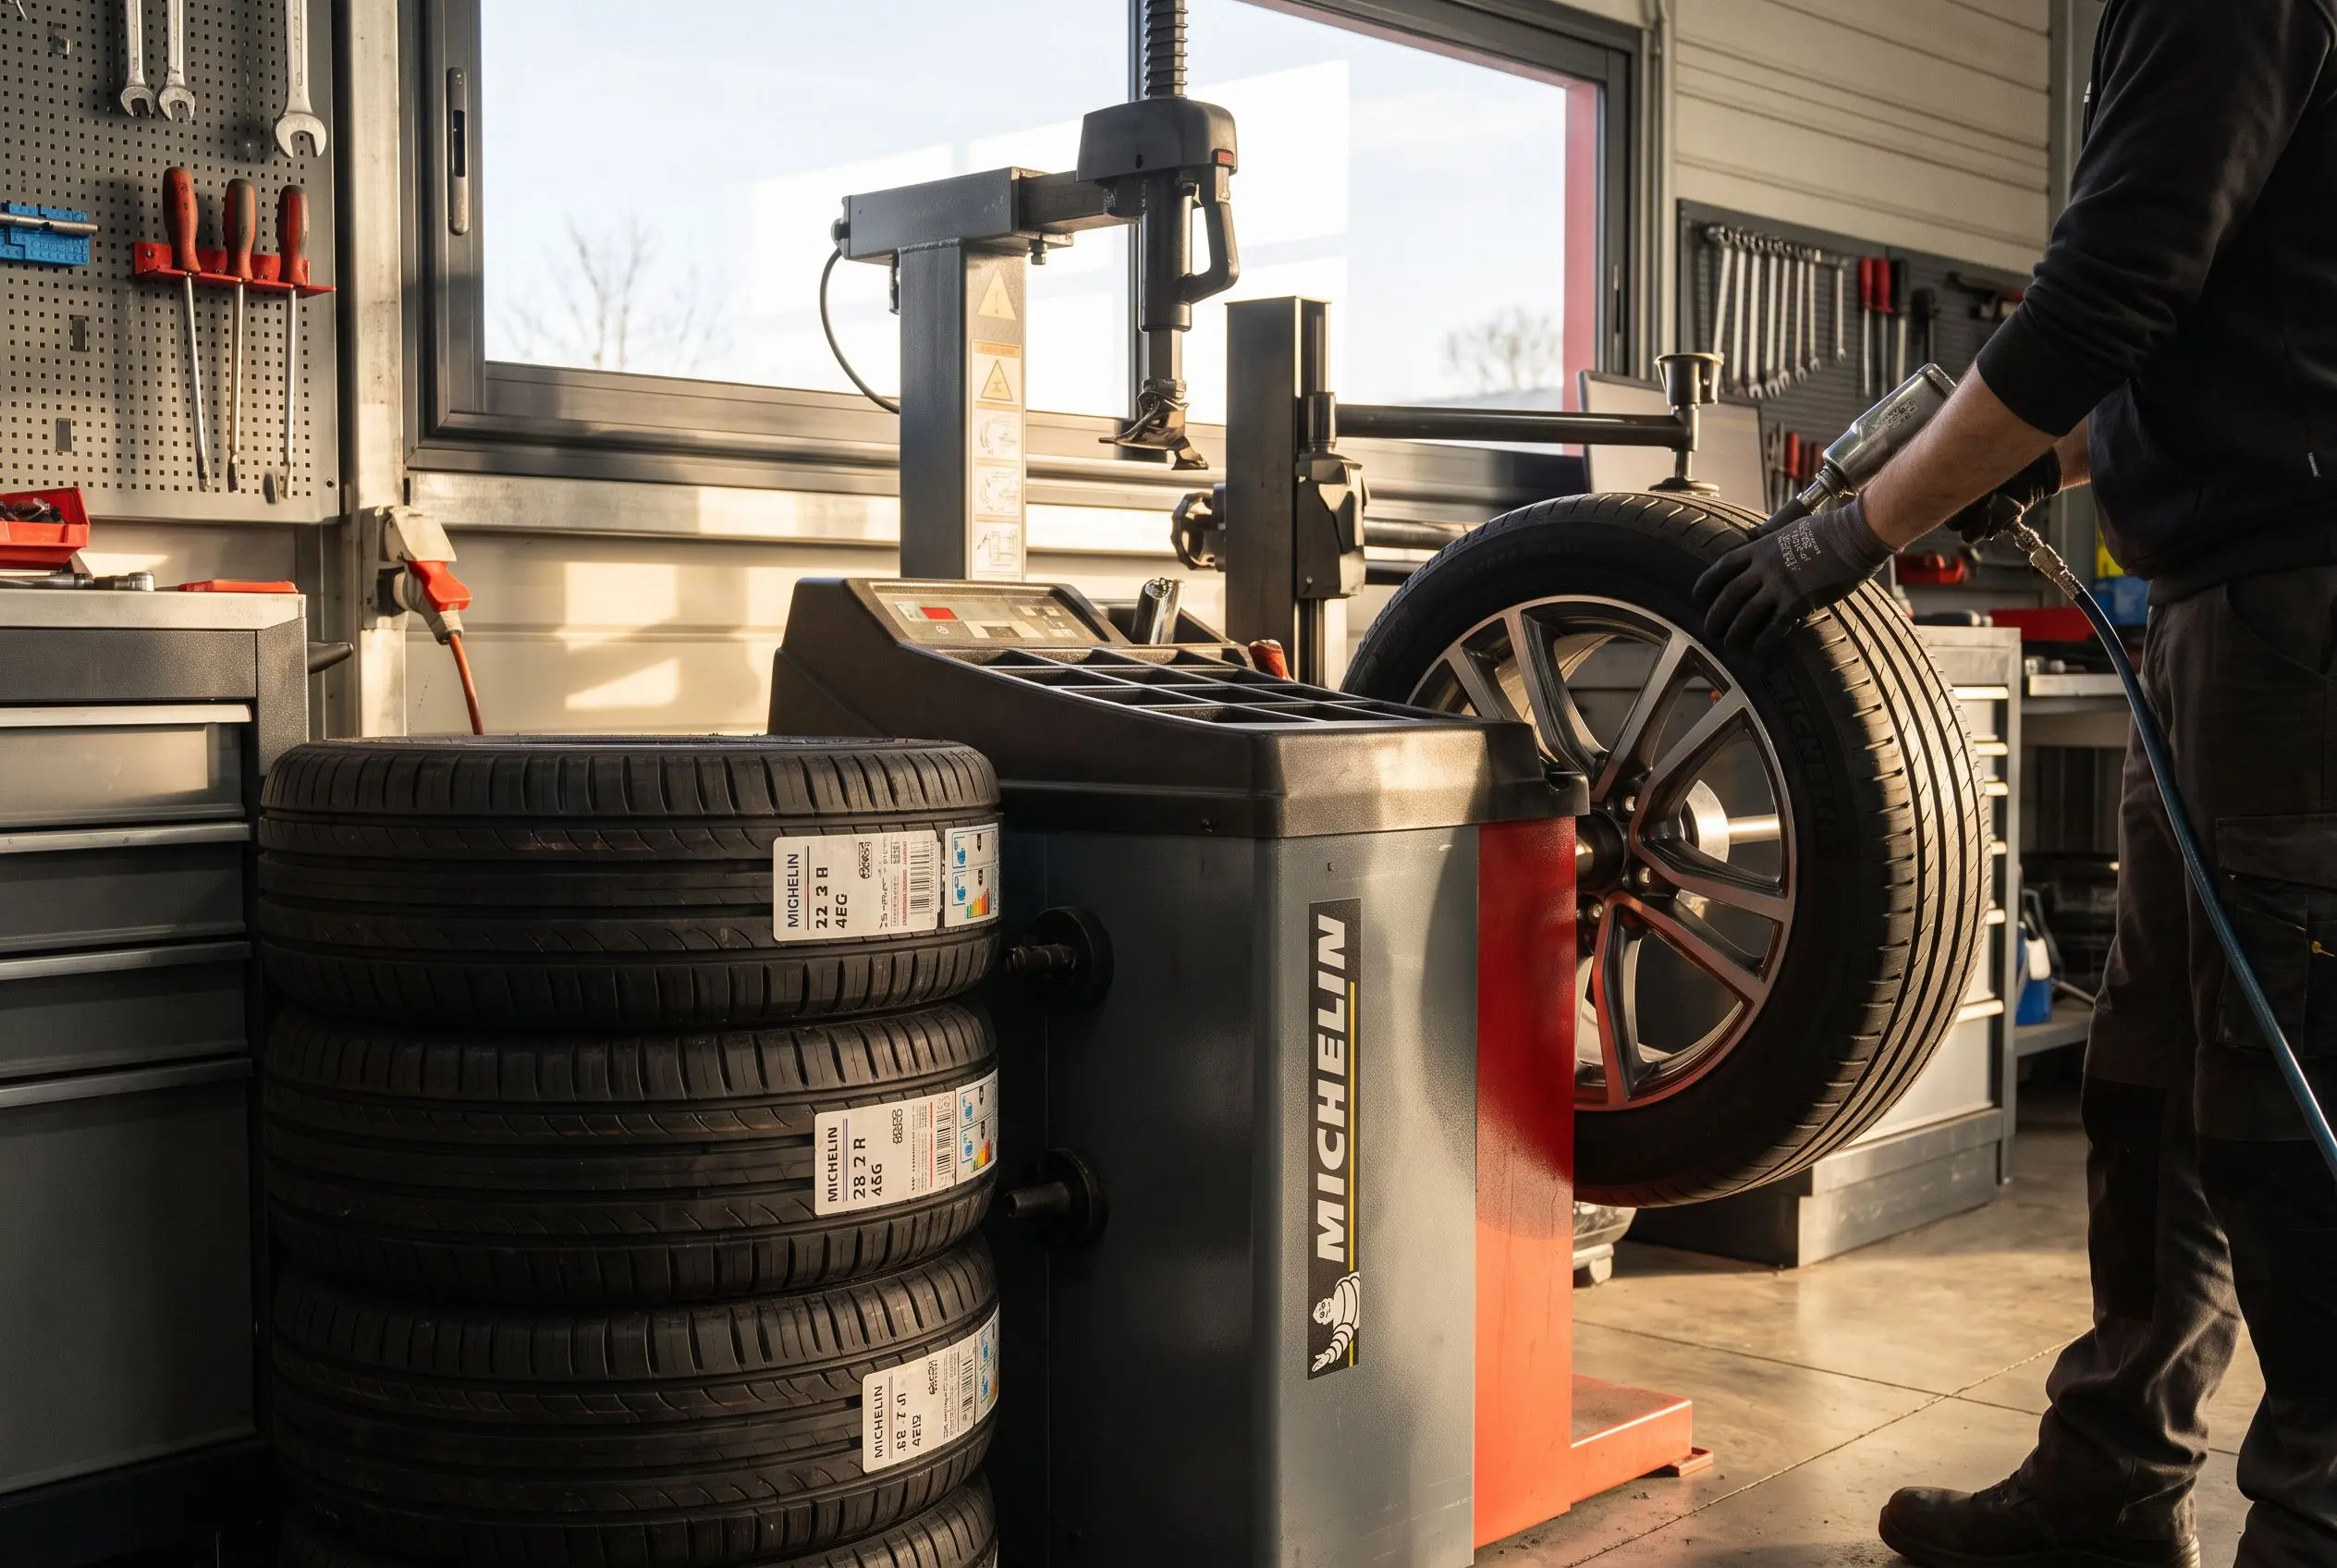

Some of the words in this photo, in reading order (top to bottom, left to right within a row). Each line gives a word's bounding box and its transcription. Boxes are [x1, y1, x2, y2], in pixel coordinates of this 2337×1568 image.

[815, 885, 828, 897] 3
[815, 905, 828, 929] 22
[835, 893, 848, 929] 4EG
[1317, 913, 1345, 1263] MICHELIN
[853, 1137, 866, 1150] R
[827, 1126, 838, 1203] MICHELIN
[853, 1175, 866, 1200] 28
[874, 1385, 883, 1459] MICHELIN
